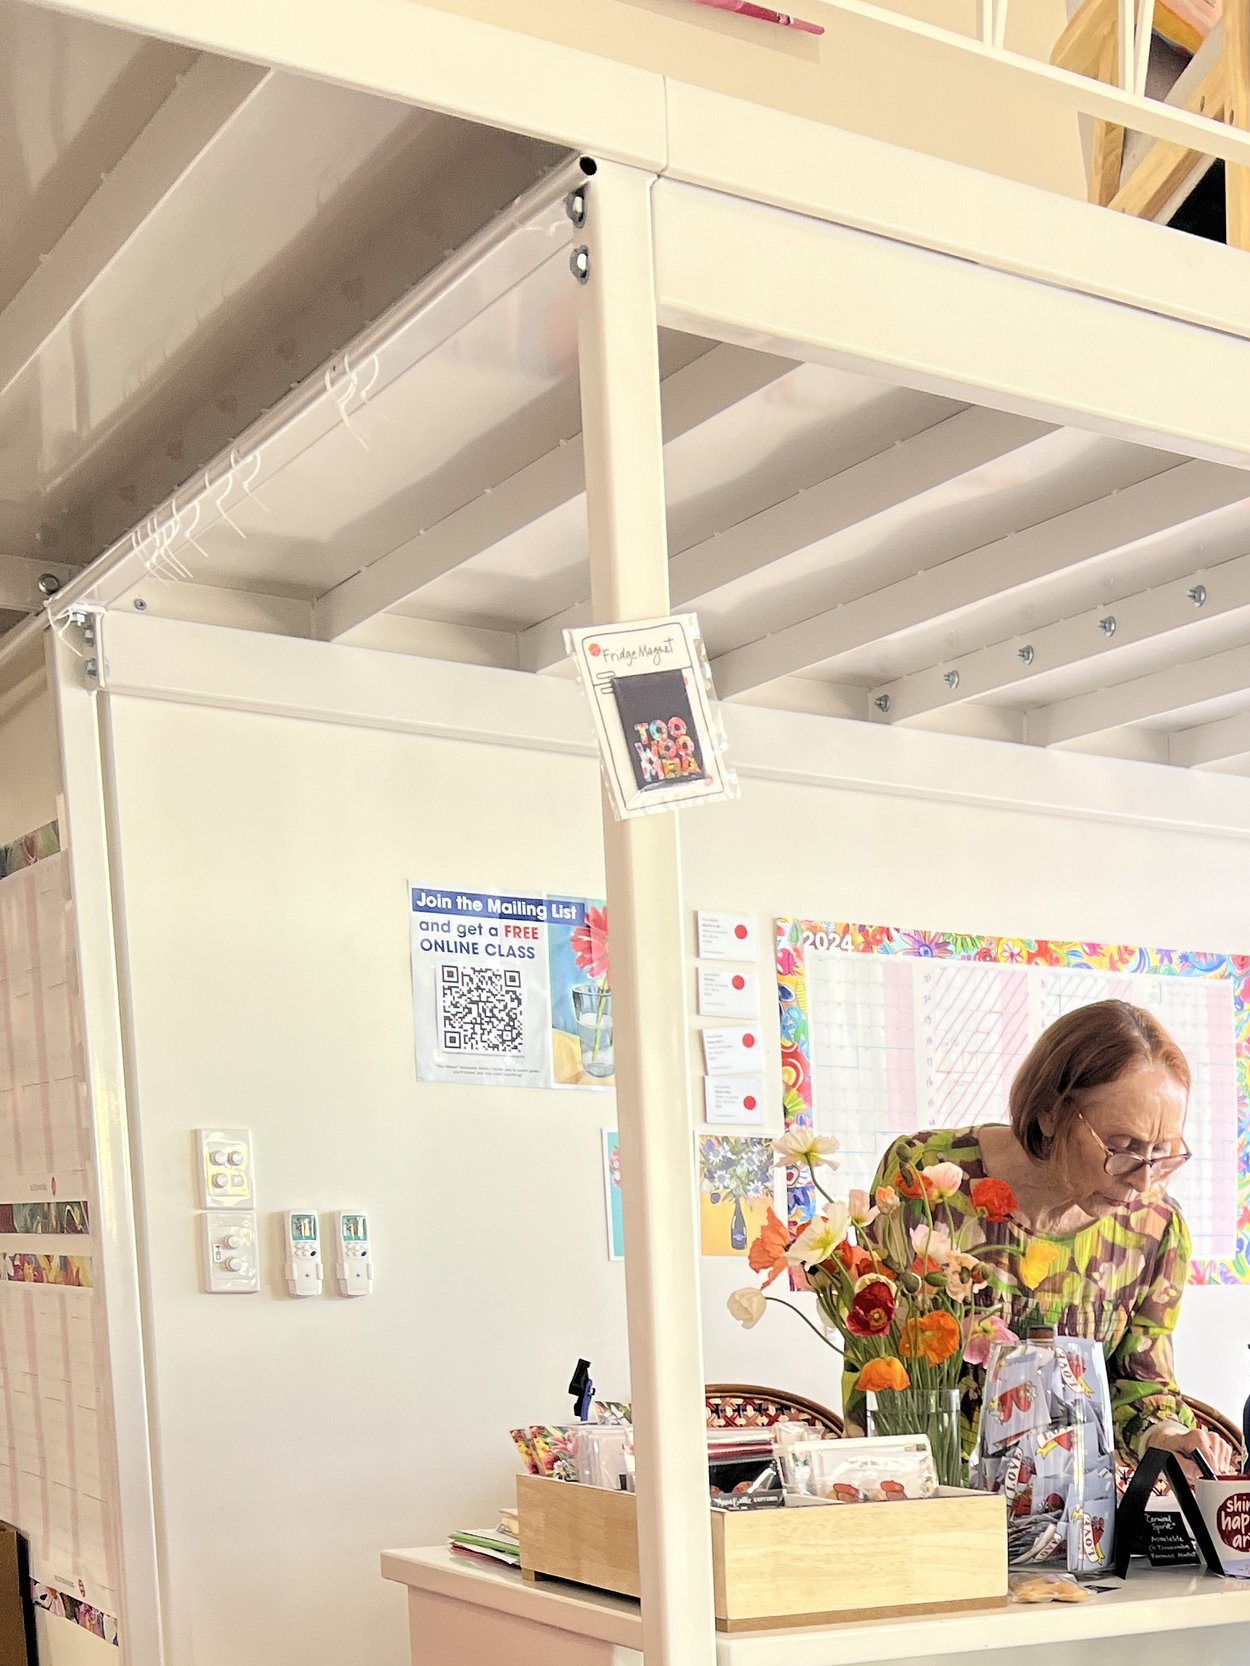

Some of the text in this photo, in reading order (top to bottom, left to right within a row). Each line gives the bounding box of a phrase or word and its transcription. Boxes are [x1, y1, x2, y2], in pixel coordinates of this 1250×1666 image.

[602, 637, 674, 667] Fridge Magnet
[416, 892, 577, 920] Join the Mailing List
[419, 920, 539, 940] and get a FREE
[802, 932, 853, 952] 2024
[420, 938, 536, 959] ONLINE CLASS
[1007, 1452, 1022, 1491] LOVE
[1084, 1516, 1095, 1557] LOVE
